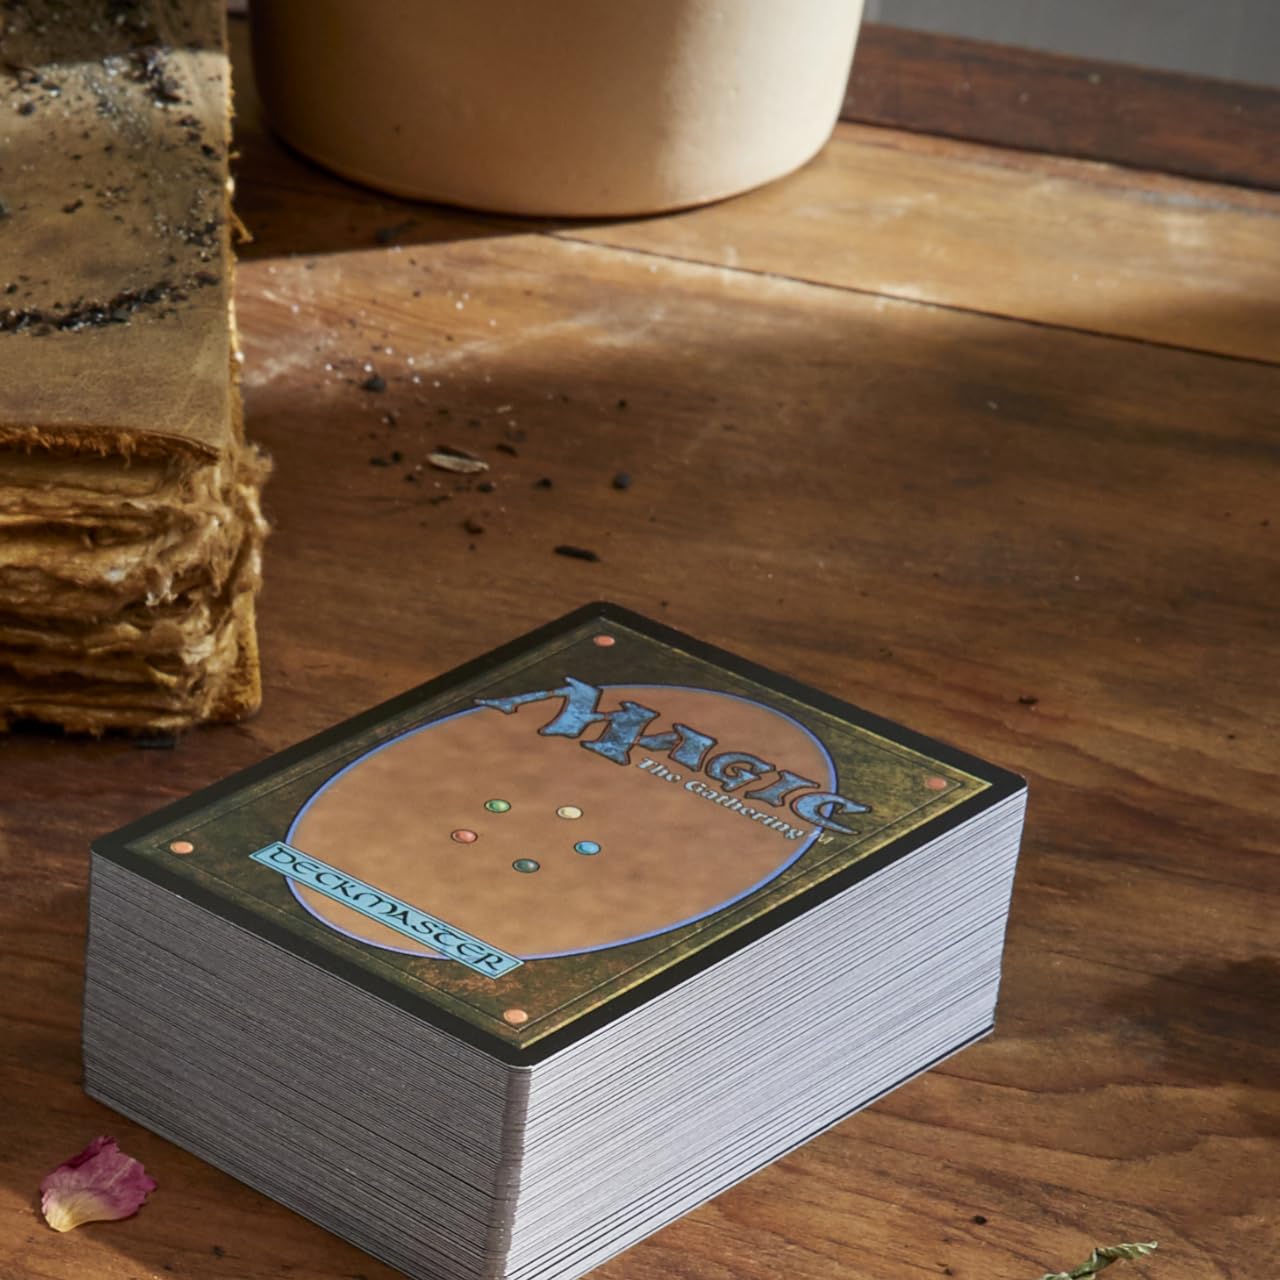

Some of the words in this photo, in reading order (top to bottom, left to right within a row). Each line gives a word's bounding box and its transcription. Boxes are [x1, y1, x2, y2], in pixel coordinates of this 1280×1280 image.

[635, 756, 683, 784] The
[682, 778, 806, 841] Gathering
[268, 846, 507, 972] DECKMASTER
